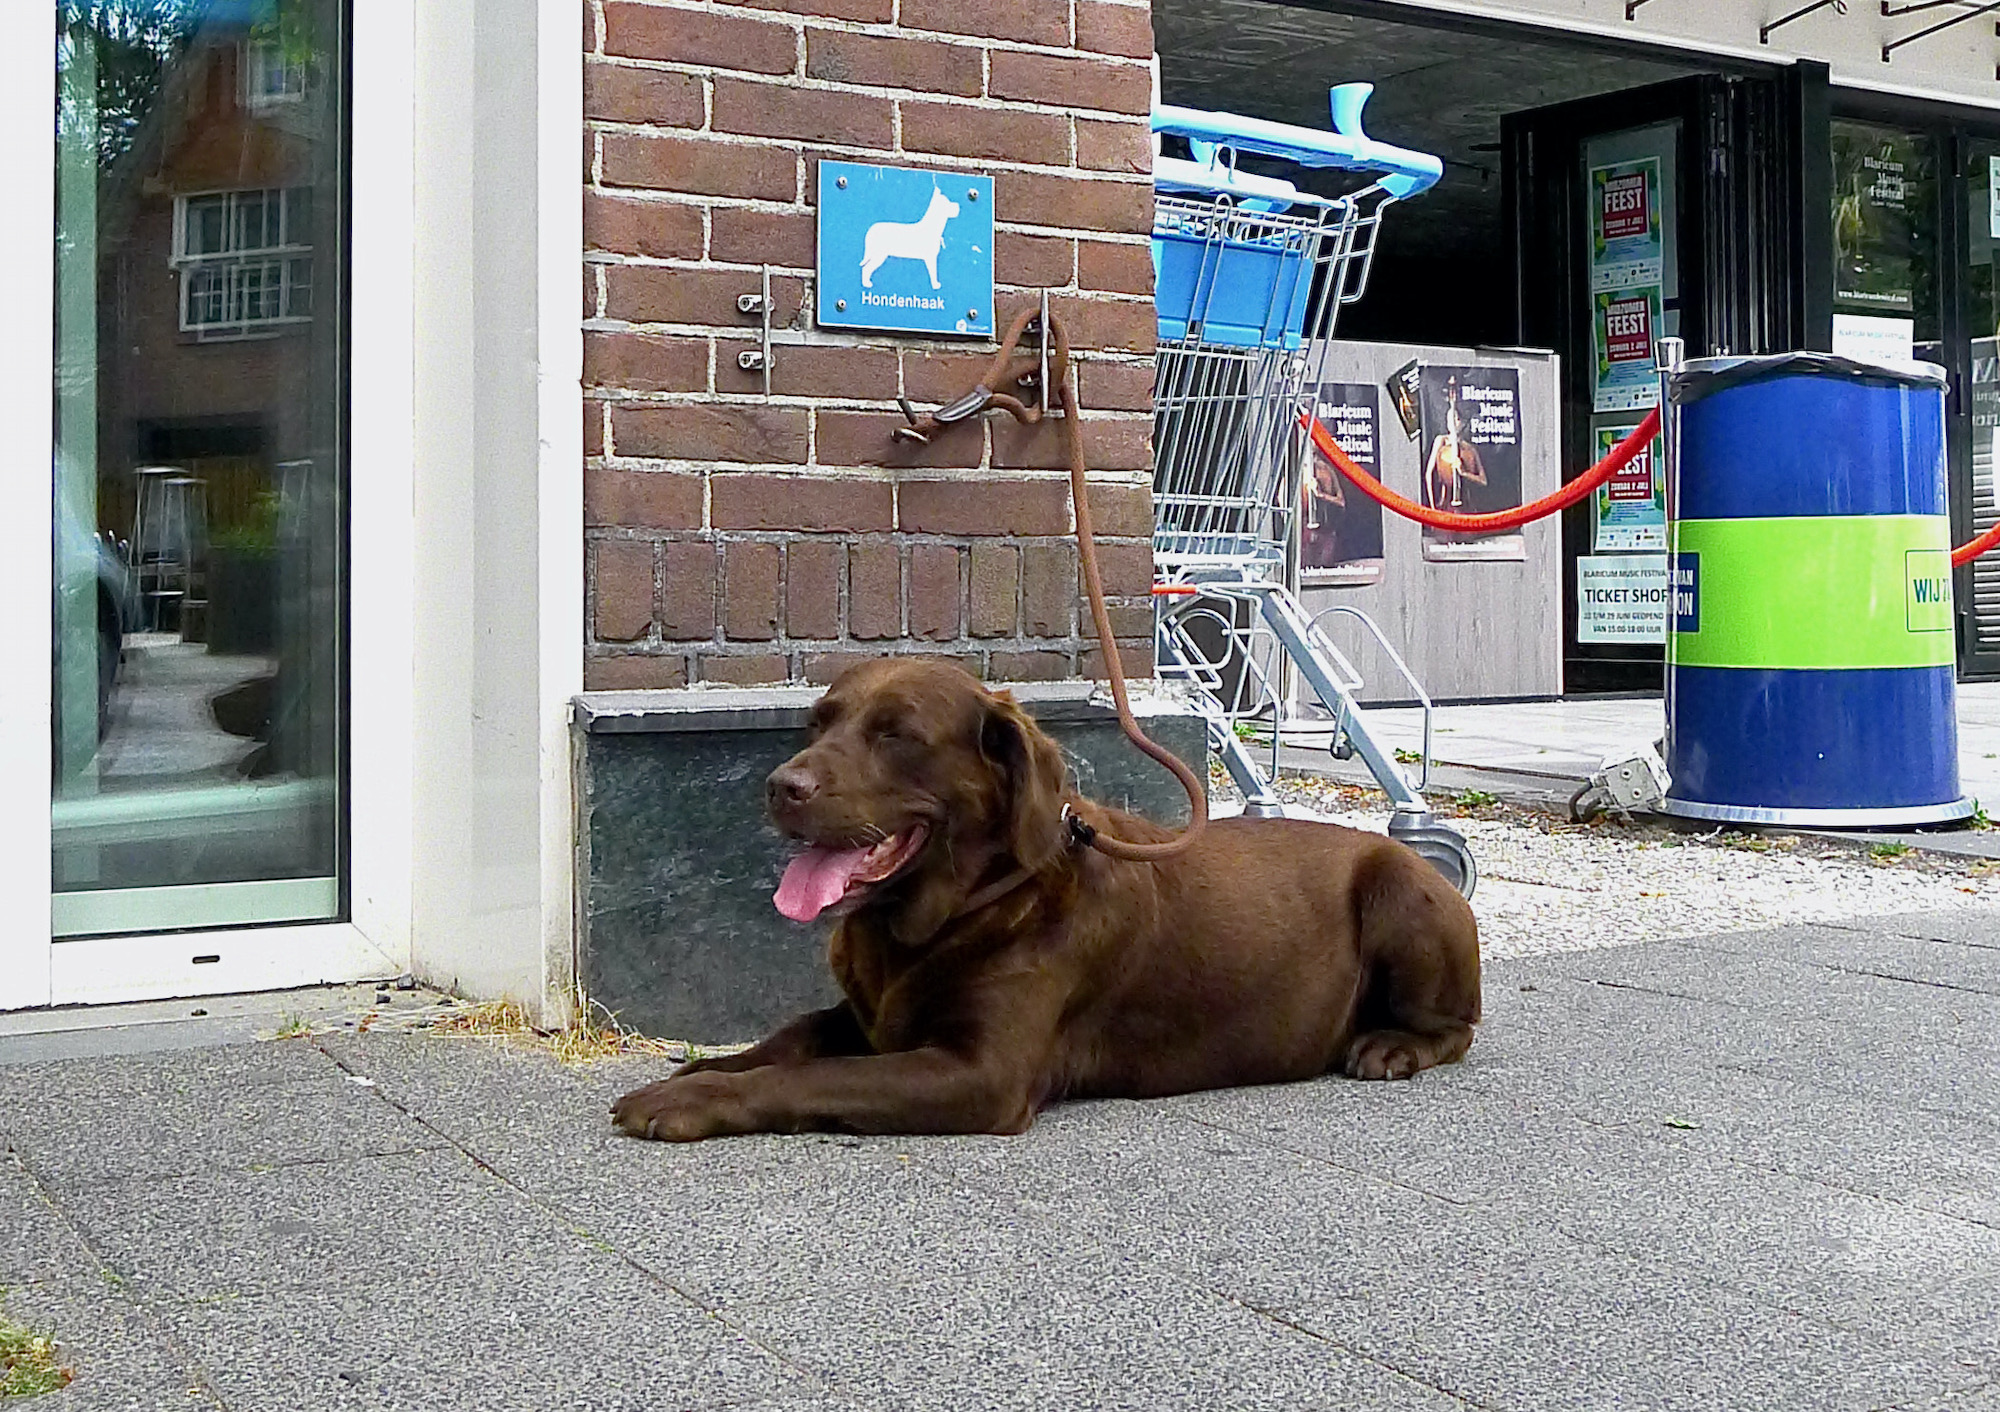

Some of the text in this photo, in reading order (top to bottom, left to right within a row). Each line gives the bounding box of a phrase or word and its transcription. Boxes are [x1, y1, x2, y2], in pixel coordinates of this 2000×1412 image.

[1863, 156, 1904, 172] Blaricum
[1876, 172, 1904, 184] Music
[1869, 184, 1904, 200] Festival
[1604, 188, 1643, 214] FEEST
[861, 291, 945, 310] Hondenhaak
[1607, 312, 1646, 337] FEEST
[1461, 385, 1514, 402] Blaricum
[1318, 402, 1373, 419] Blaricum
[1479, 402, 1514, 418] Music
[1336, 420, 1373, 436] Music
[1470, 417, 1515, 434] Festival
[1583, 570, 1618, 578] BLARICUM
[1619, 570, 1640, 578] MUSIC
[1584, 588, 1629, 603] TICKET
[1912, 578, 1940, 604] WIJ
[1592, 625, 1607, 633] VAN
[1646, 625, 1662, 633] UUR
